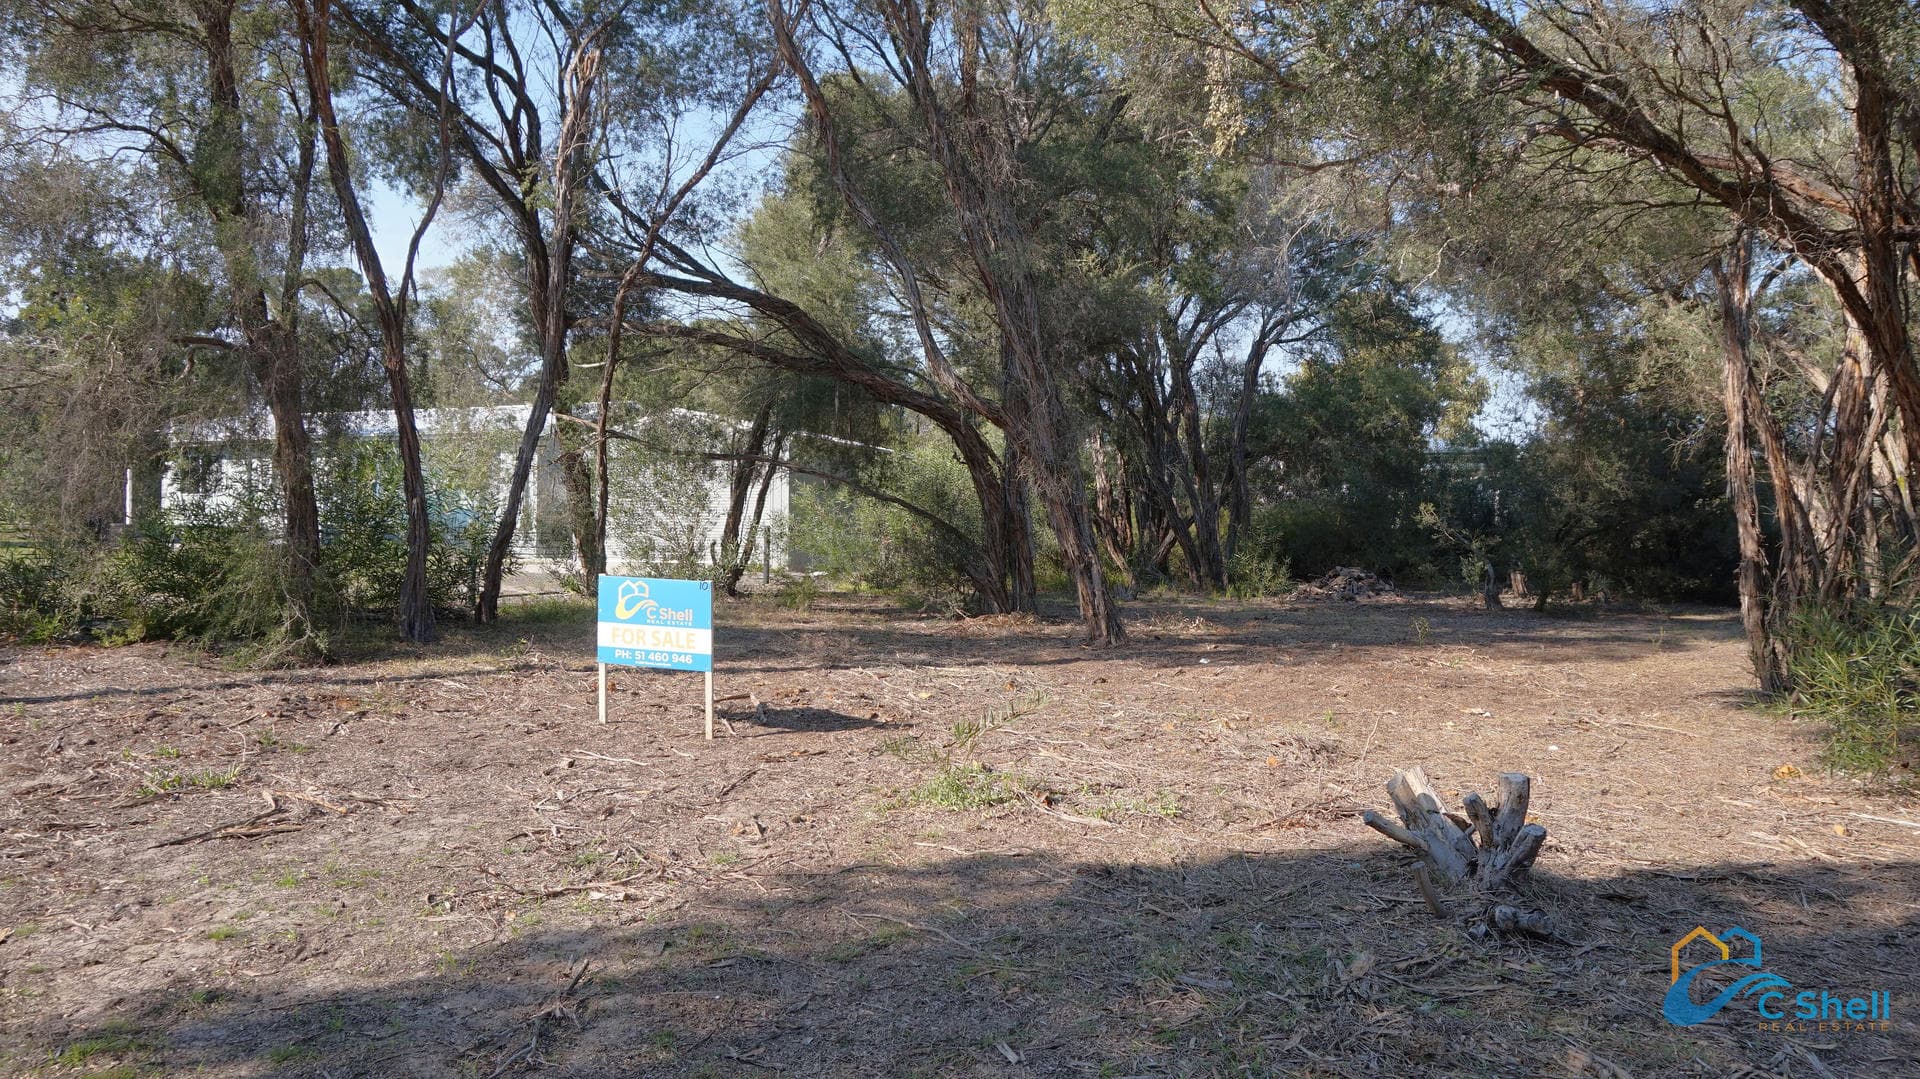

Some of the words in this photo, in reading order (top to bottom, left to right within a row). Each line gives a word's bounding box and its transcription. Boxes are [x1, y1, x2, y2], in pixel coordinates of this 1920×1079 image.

[646, 608, 657, 619] C
[660, 608, 693, 621] Shell
[612, 627, 646, 646] FOR
[650, 631, 696, 650] SALE
[615, 649, 632, 660] PH:
[635, 650, 646, 660] 51
[648, 651, 669, 662] 460
[672, 653, 692, 664] 946
